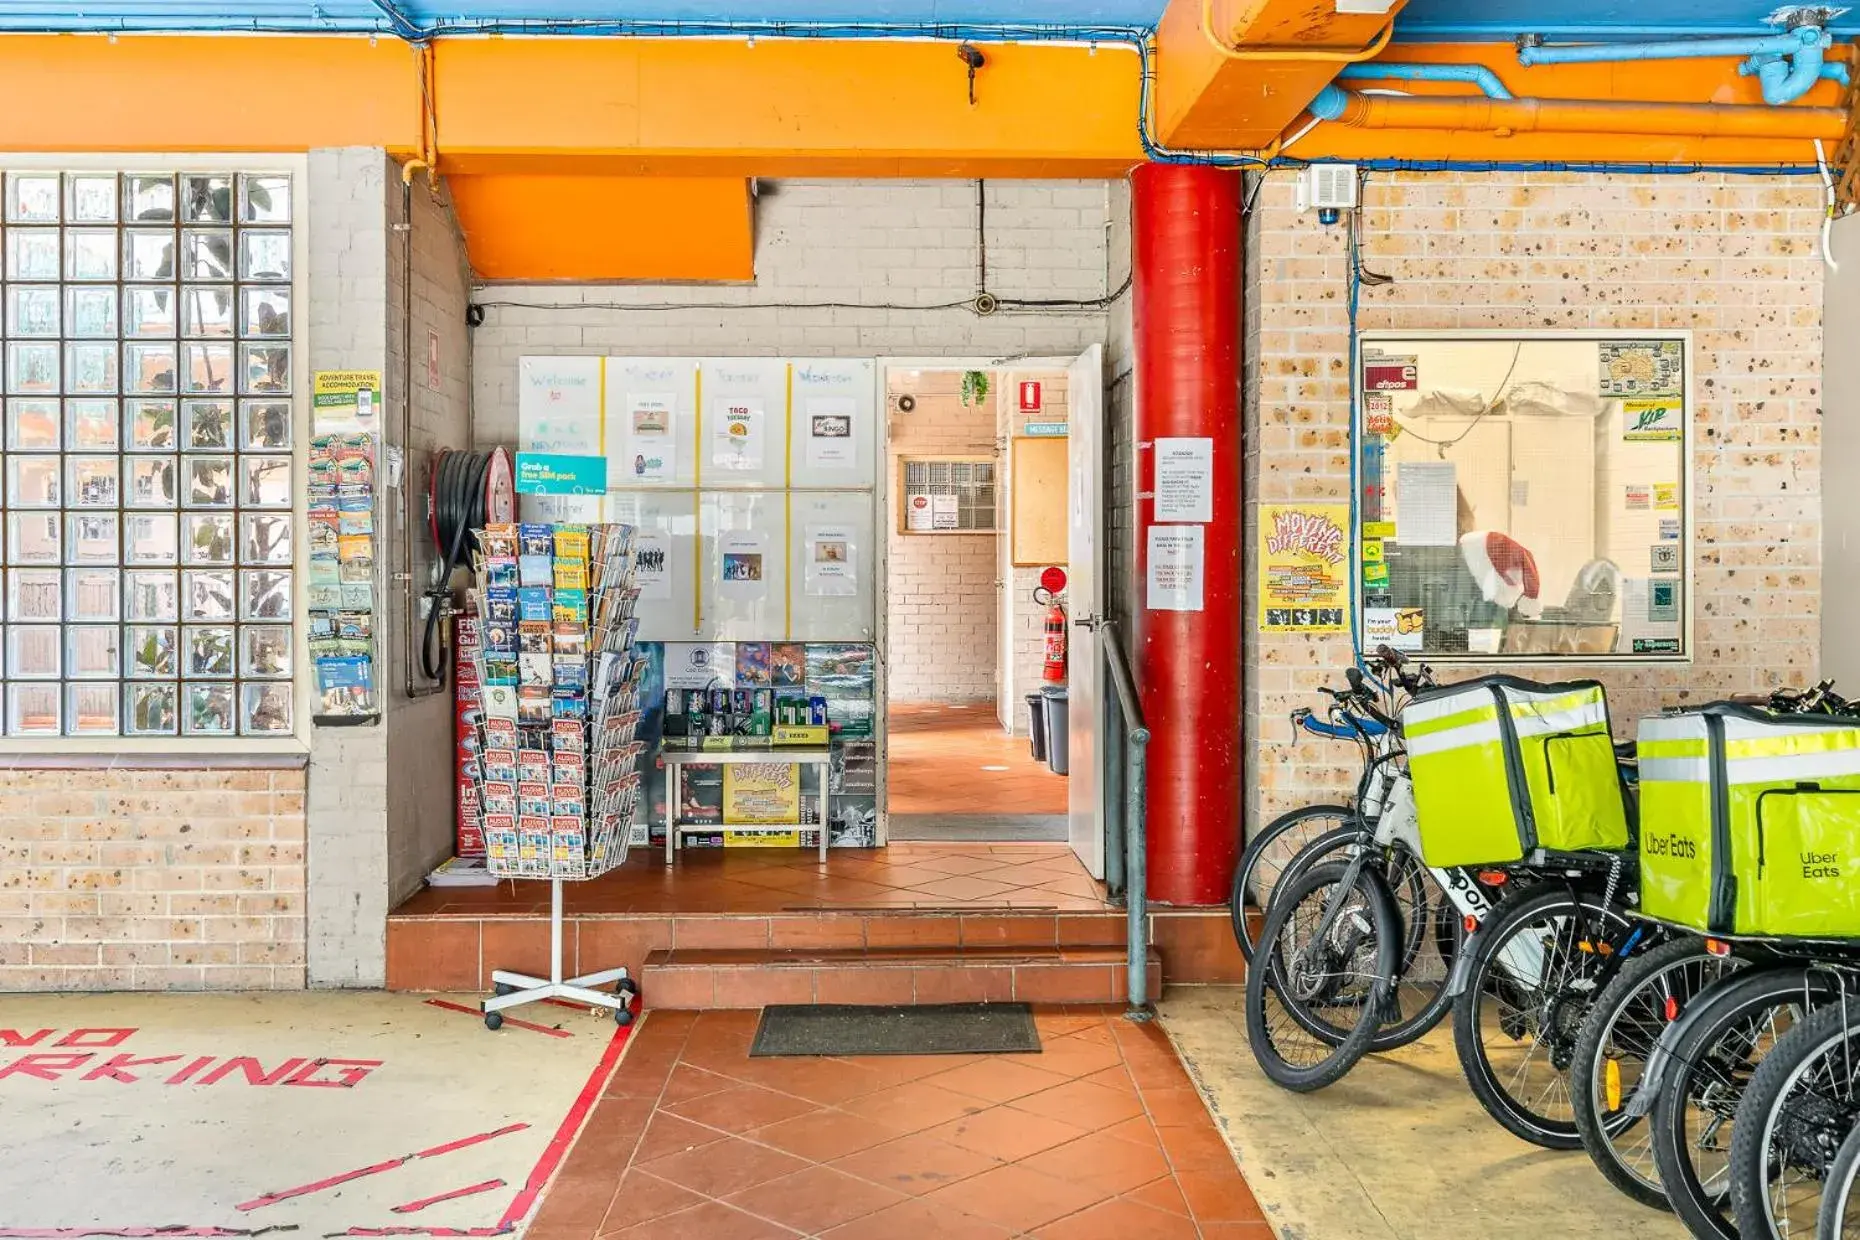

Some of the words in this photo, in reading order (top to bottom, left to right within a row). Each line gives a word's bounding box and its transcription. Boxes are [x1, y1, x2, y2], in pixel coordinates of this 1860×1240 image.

[1376, 380, 1407, 390] eftpos
[521, 463, 542, 471] Grab
[1274, 511, 1344, 546] MOVING
[1266, 534, 1345, 566] DIFFERENT
[1646, 832, 1670, 856] Uber
[1670, 833, 1696, 859] Eats
[1801, 852, 1837, 864] Uber
[1803, 865, 1840, 879] Eats
